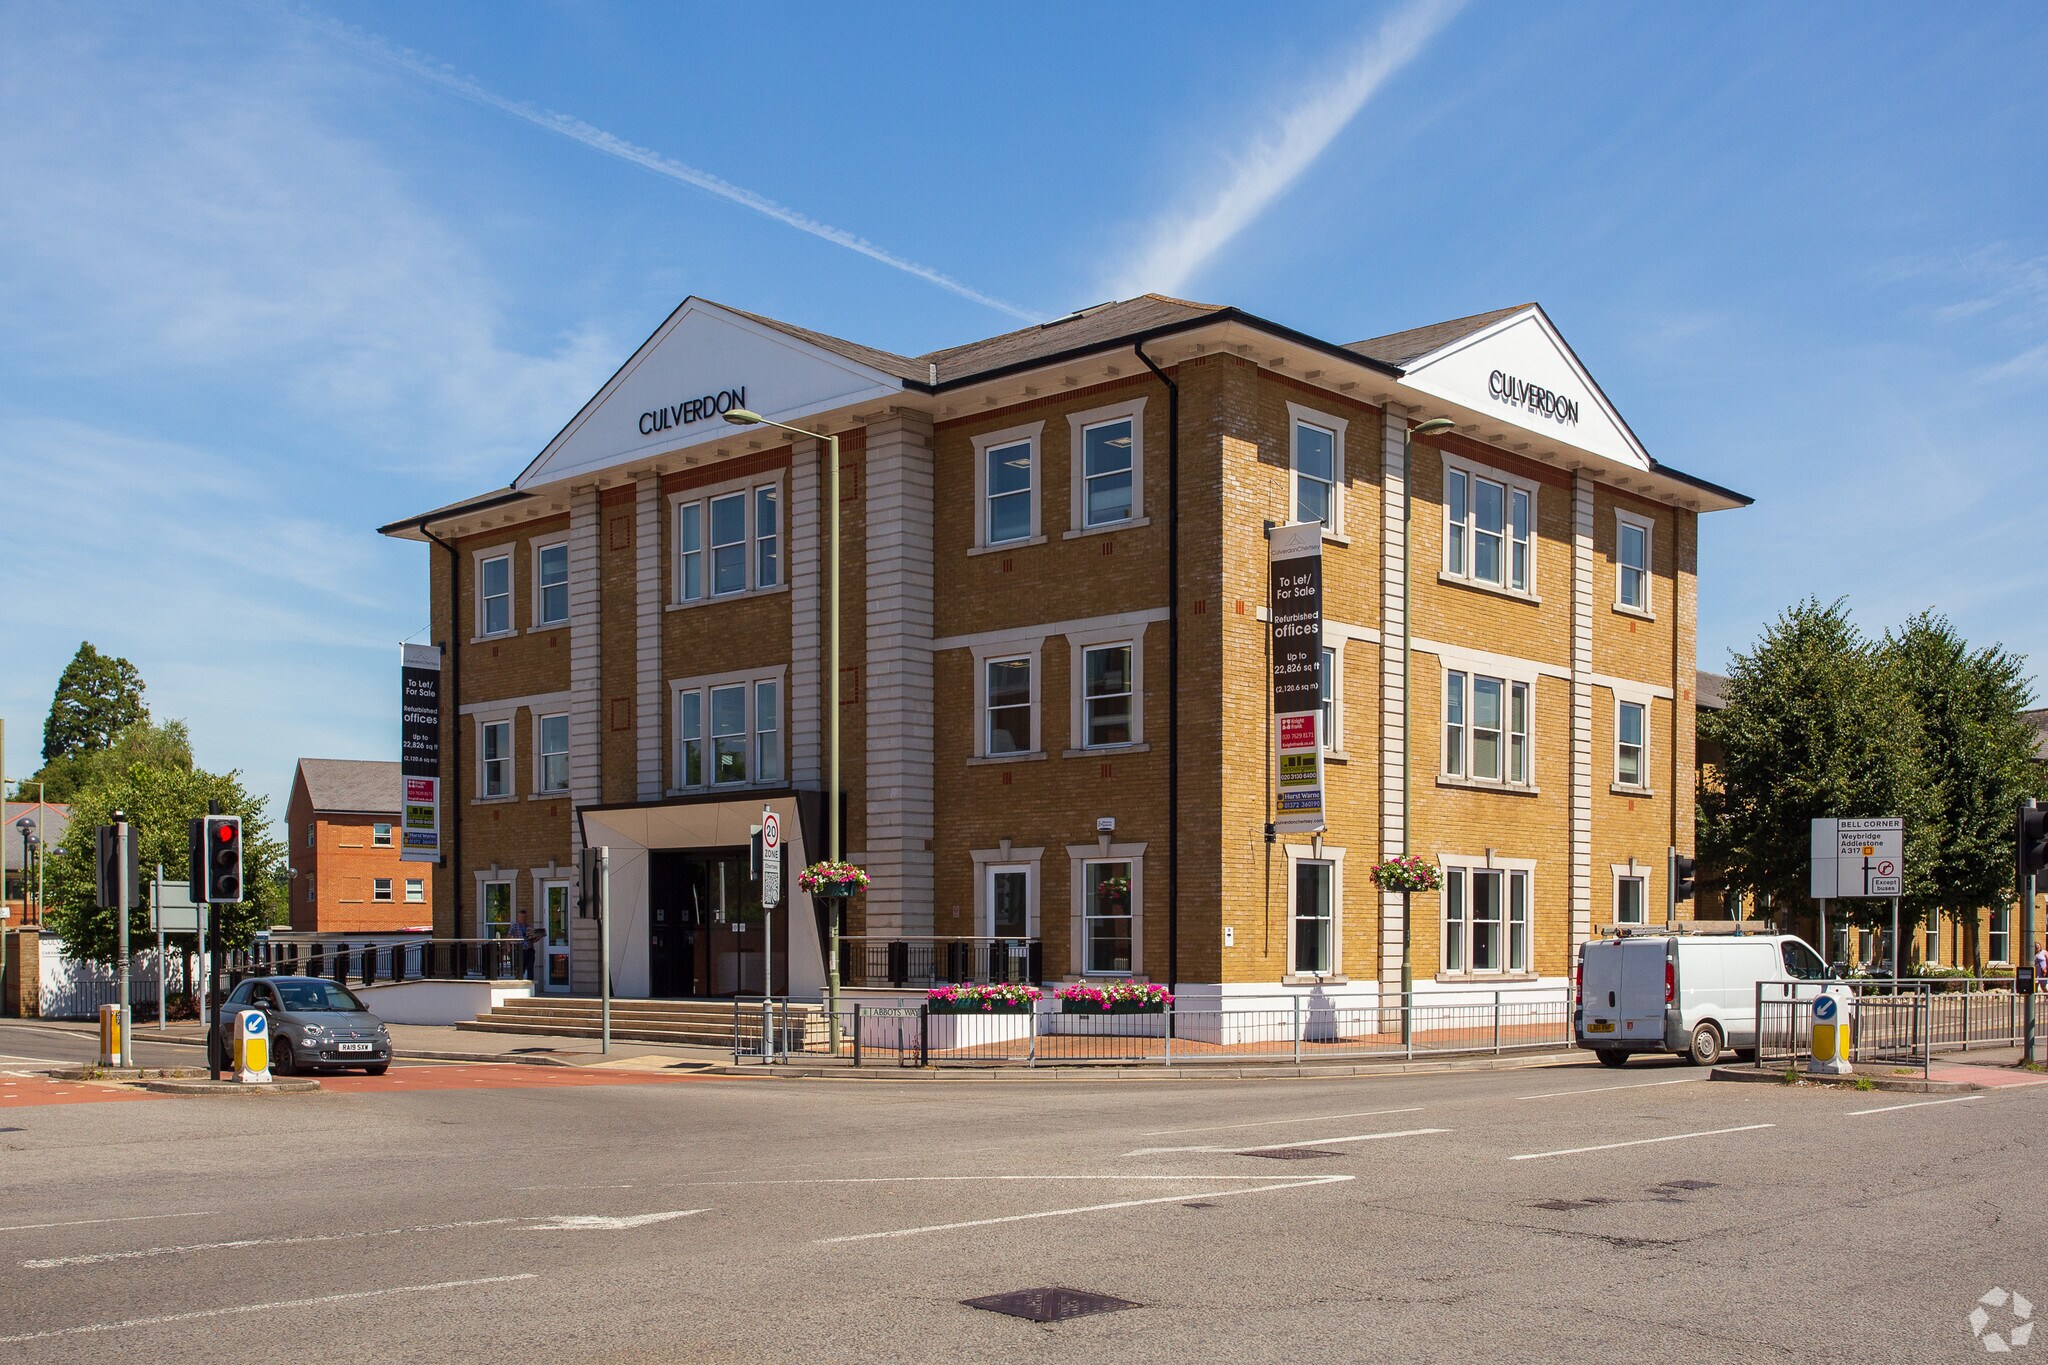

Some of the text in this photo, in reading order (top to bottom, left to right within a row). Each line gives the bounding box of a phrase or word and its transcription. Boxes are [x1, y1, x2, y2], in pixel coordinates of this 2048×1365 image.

[1490, 369, 1579, 423] CULVERDON
[639, 385, 745, 435] CULVERDON
[1279, 573, 1312, 587] To Let/
[1277, 586, 1315, 599] For Sale
[1274, 611, 1319, 624] Refurbished
[1274, 623, 1319, 638] offices
[1287, 652, 1307, 662] Up to
[1274, 662, 1320, 675] 22,826 sq ft
[408, 679, 434, 689] To Let/
[405, 687, 436, 697] For Sale
[403, 705, 438, 715] Refurbished
[403, 713, 438, 725] offices
[412, 733, 421, 741] Up
[403, 741, 425, 749] 22,826
[1284, 791, 1320, 800] Hurst Warne
[1864, 820, 1900, 828] CORNER
[766, 825, 776, 838] 20
[1841, 833, 1881, 841] Weybridge
[764, 849, 778, 859] ZONE
[873, 1008, 919, 1016] ABBOTS WAY
